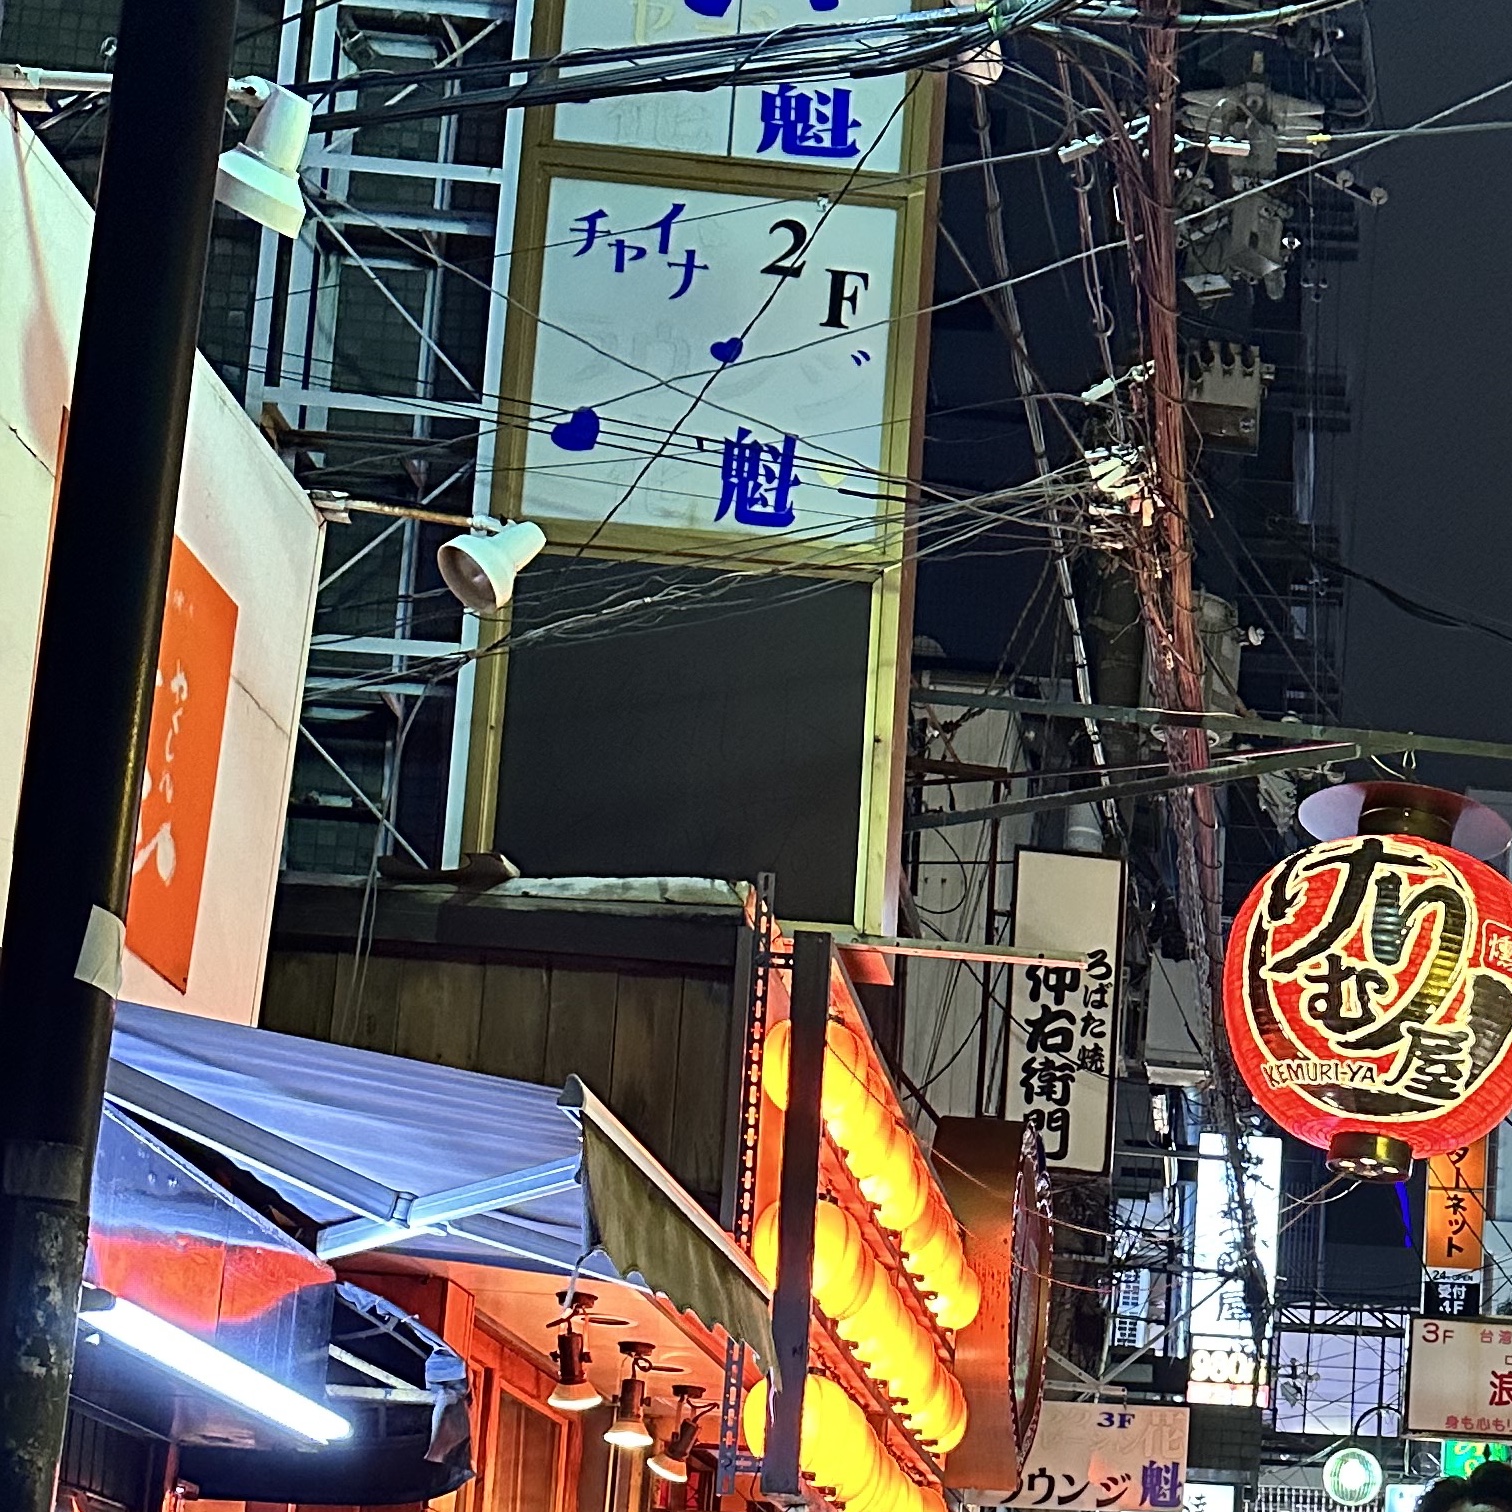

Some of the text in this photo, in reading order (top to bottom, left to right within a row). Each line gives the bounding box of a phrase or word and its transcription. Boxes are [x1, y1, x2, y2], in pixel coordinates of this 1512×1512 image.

[756, 83, 862, 158] 魁
[569, 202, 709, 300] チャイナ
[760, 218, 869, 330] 2F
[714, 426, 801, 528] 魁
[1076, 949, 1114, 1074] ろばた焼
[1262, 1061, 1376, 1088] KEMURI-YA
[1421, 1322, 1455, 1345] 3F
[1096, 1411, 1136, 1429] 3F
[1139, 1459, 1184, 1508] 魁
